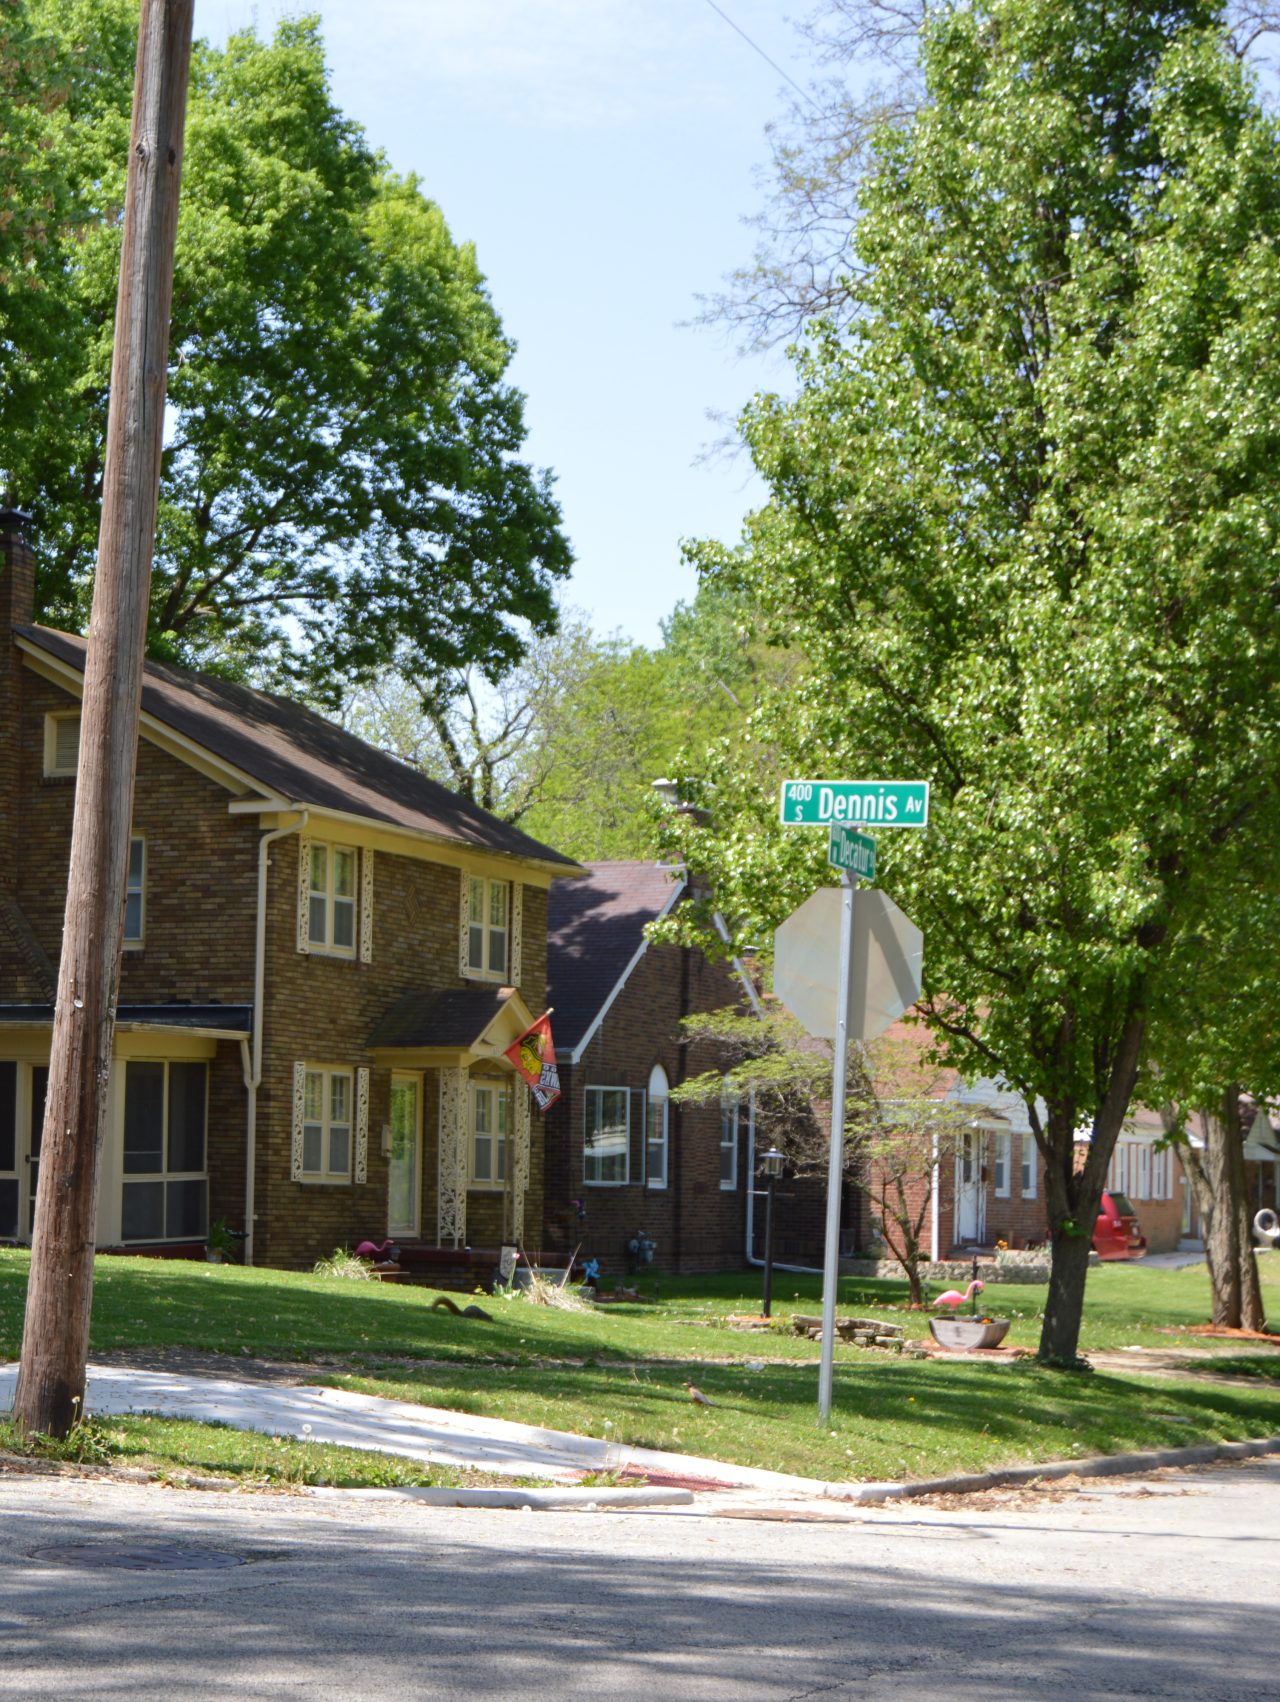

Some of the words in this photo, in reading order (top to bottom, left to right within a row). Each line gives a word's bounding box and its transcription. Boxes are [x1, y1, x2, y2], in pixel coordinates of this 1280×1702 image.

[788, 784, 813, 802] 400
[818, 787, 898, 820] Dennis
[905, 796, 923, 813] Av
[795, 805, 804, 821] S
[840, 830, 869, 873] Decatur
